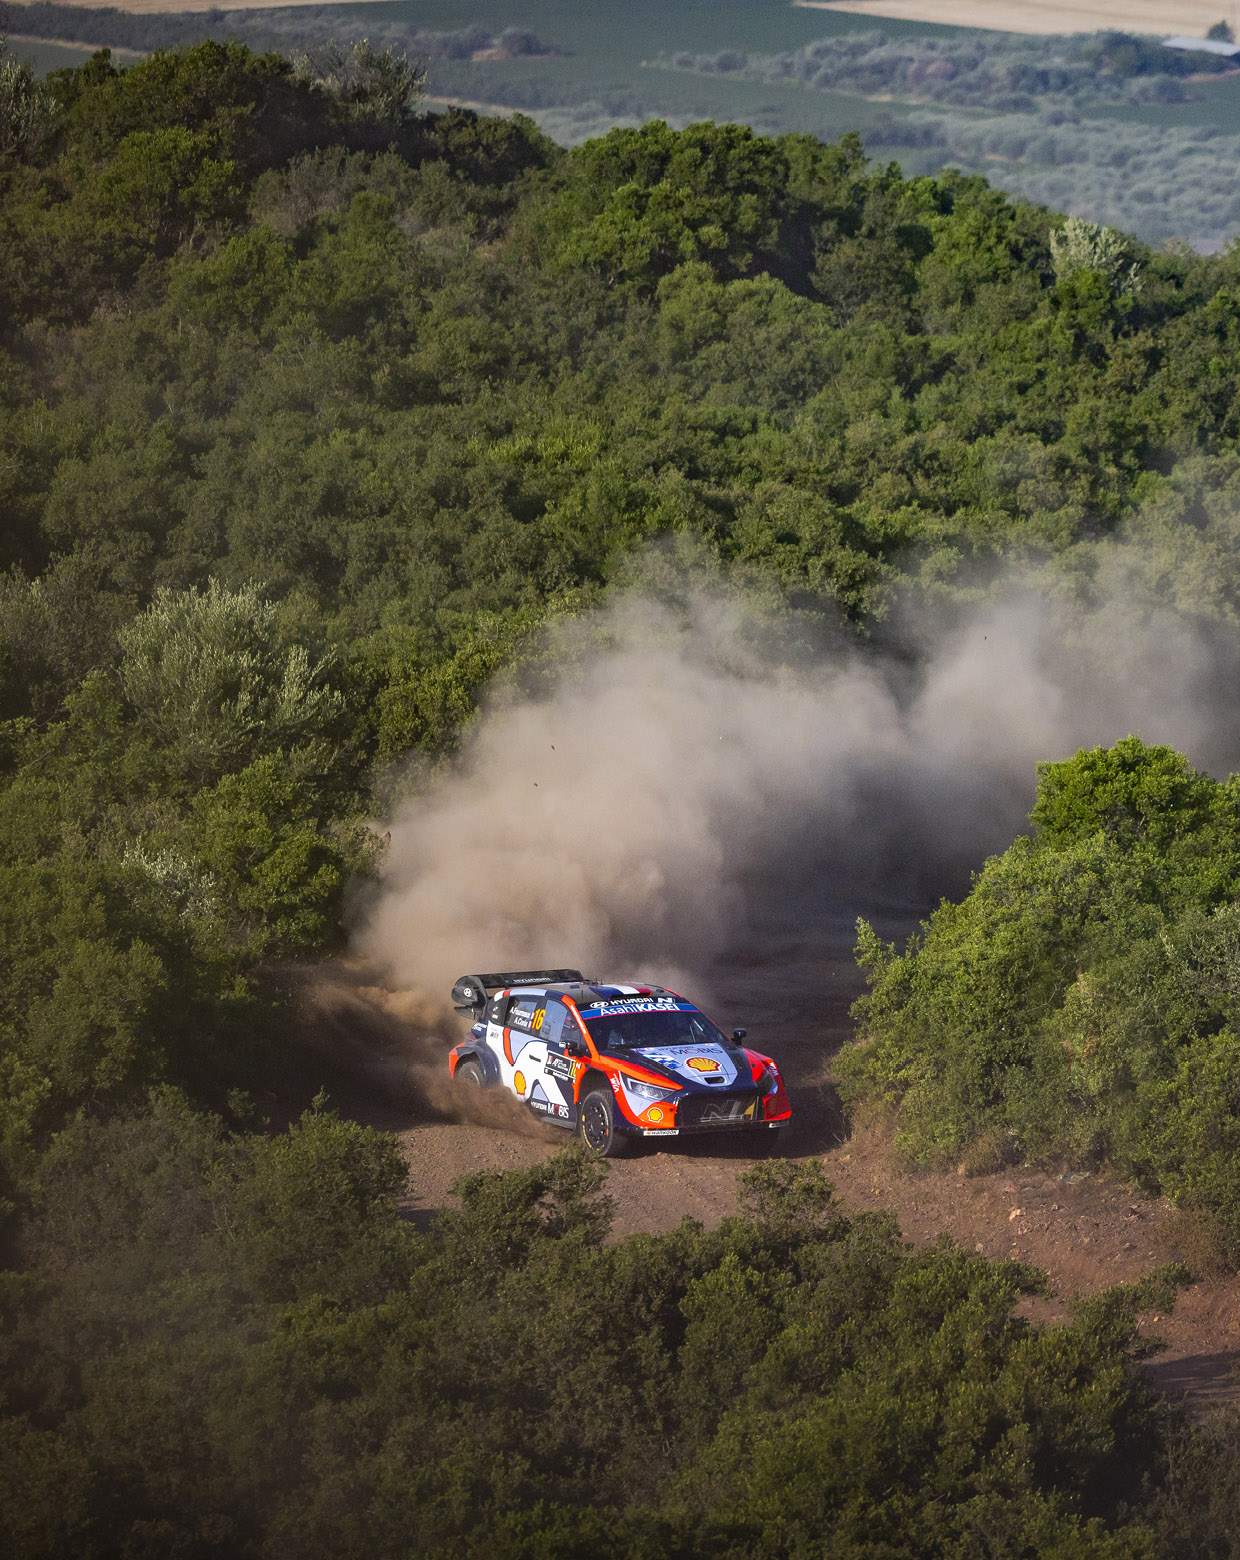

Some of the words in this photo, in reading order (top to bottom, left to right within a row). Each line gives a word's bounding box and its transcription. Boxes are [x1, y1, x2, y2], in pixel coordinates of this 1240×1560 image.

[600, 1003, 680, 1016] AsahiKASEI
[531, 1008, 546, 1030] 16
[671, 1047, 723, 1055] MOBIS
[547, 1102, 570, 1119] MOBIS
